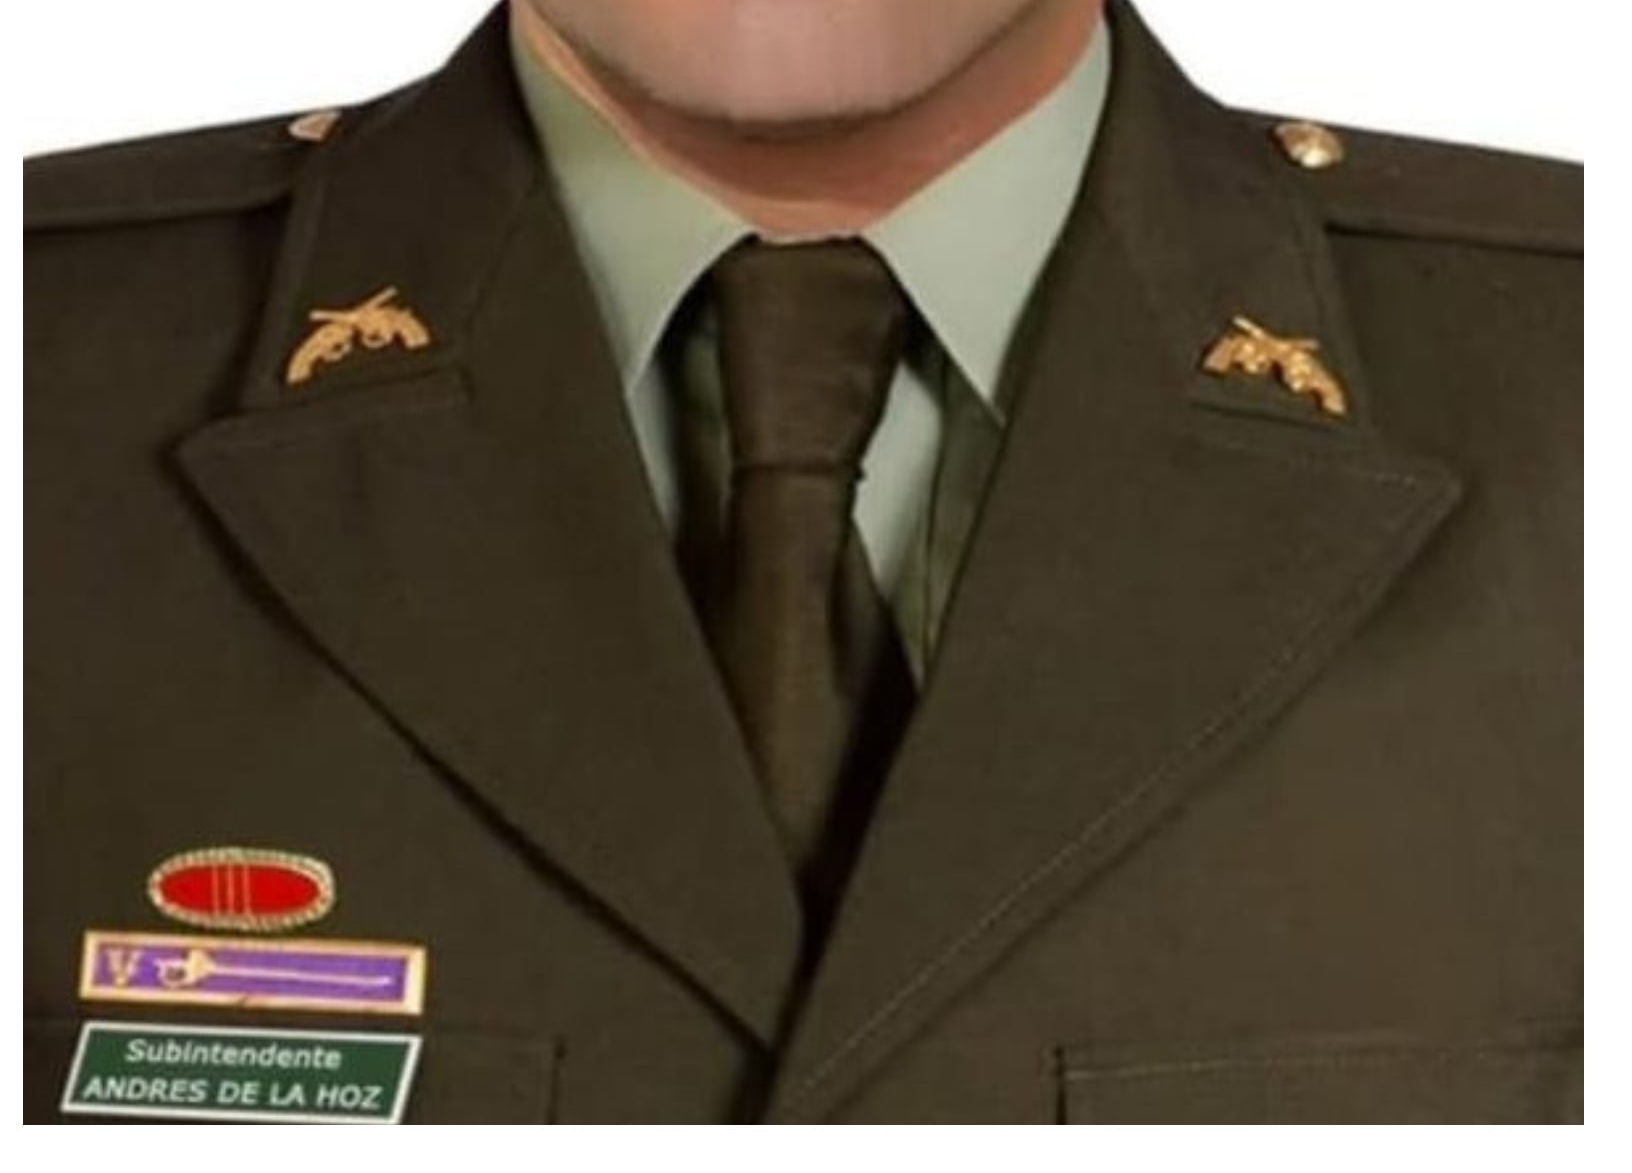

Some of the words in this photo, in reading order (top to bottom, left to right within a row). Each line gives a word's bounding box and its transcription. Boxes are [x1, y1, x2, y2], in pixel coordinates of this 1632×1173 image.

[125, 1038, 343, 1069] Subintendente
[82, 1076, 207, 1103] ANDRES
[217, 1081, 259, 1105] DE
[269, 1084, 305, 1106] LA
[316, 1085, 384, 1110] HOZ
